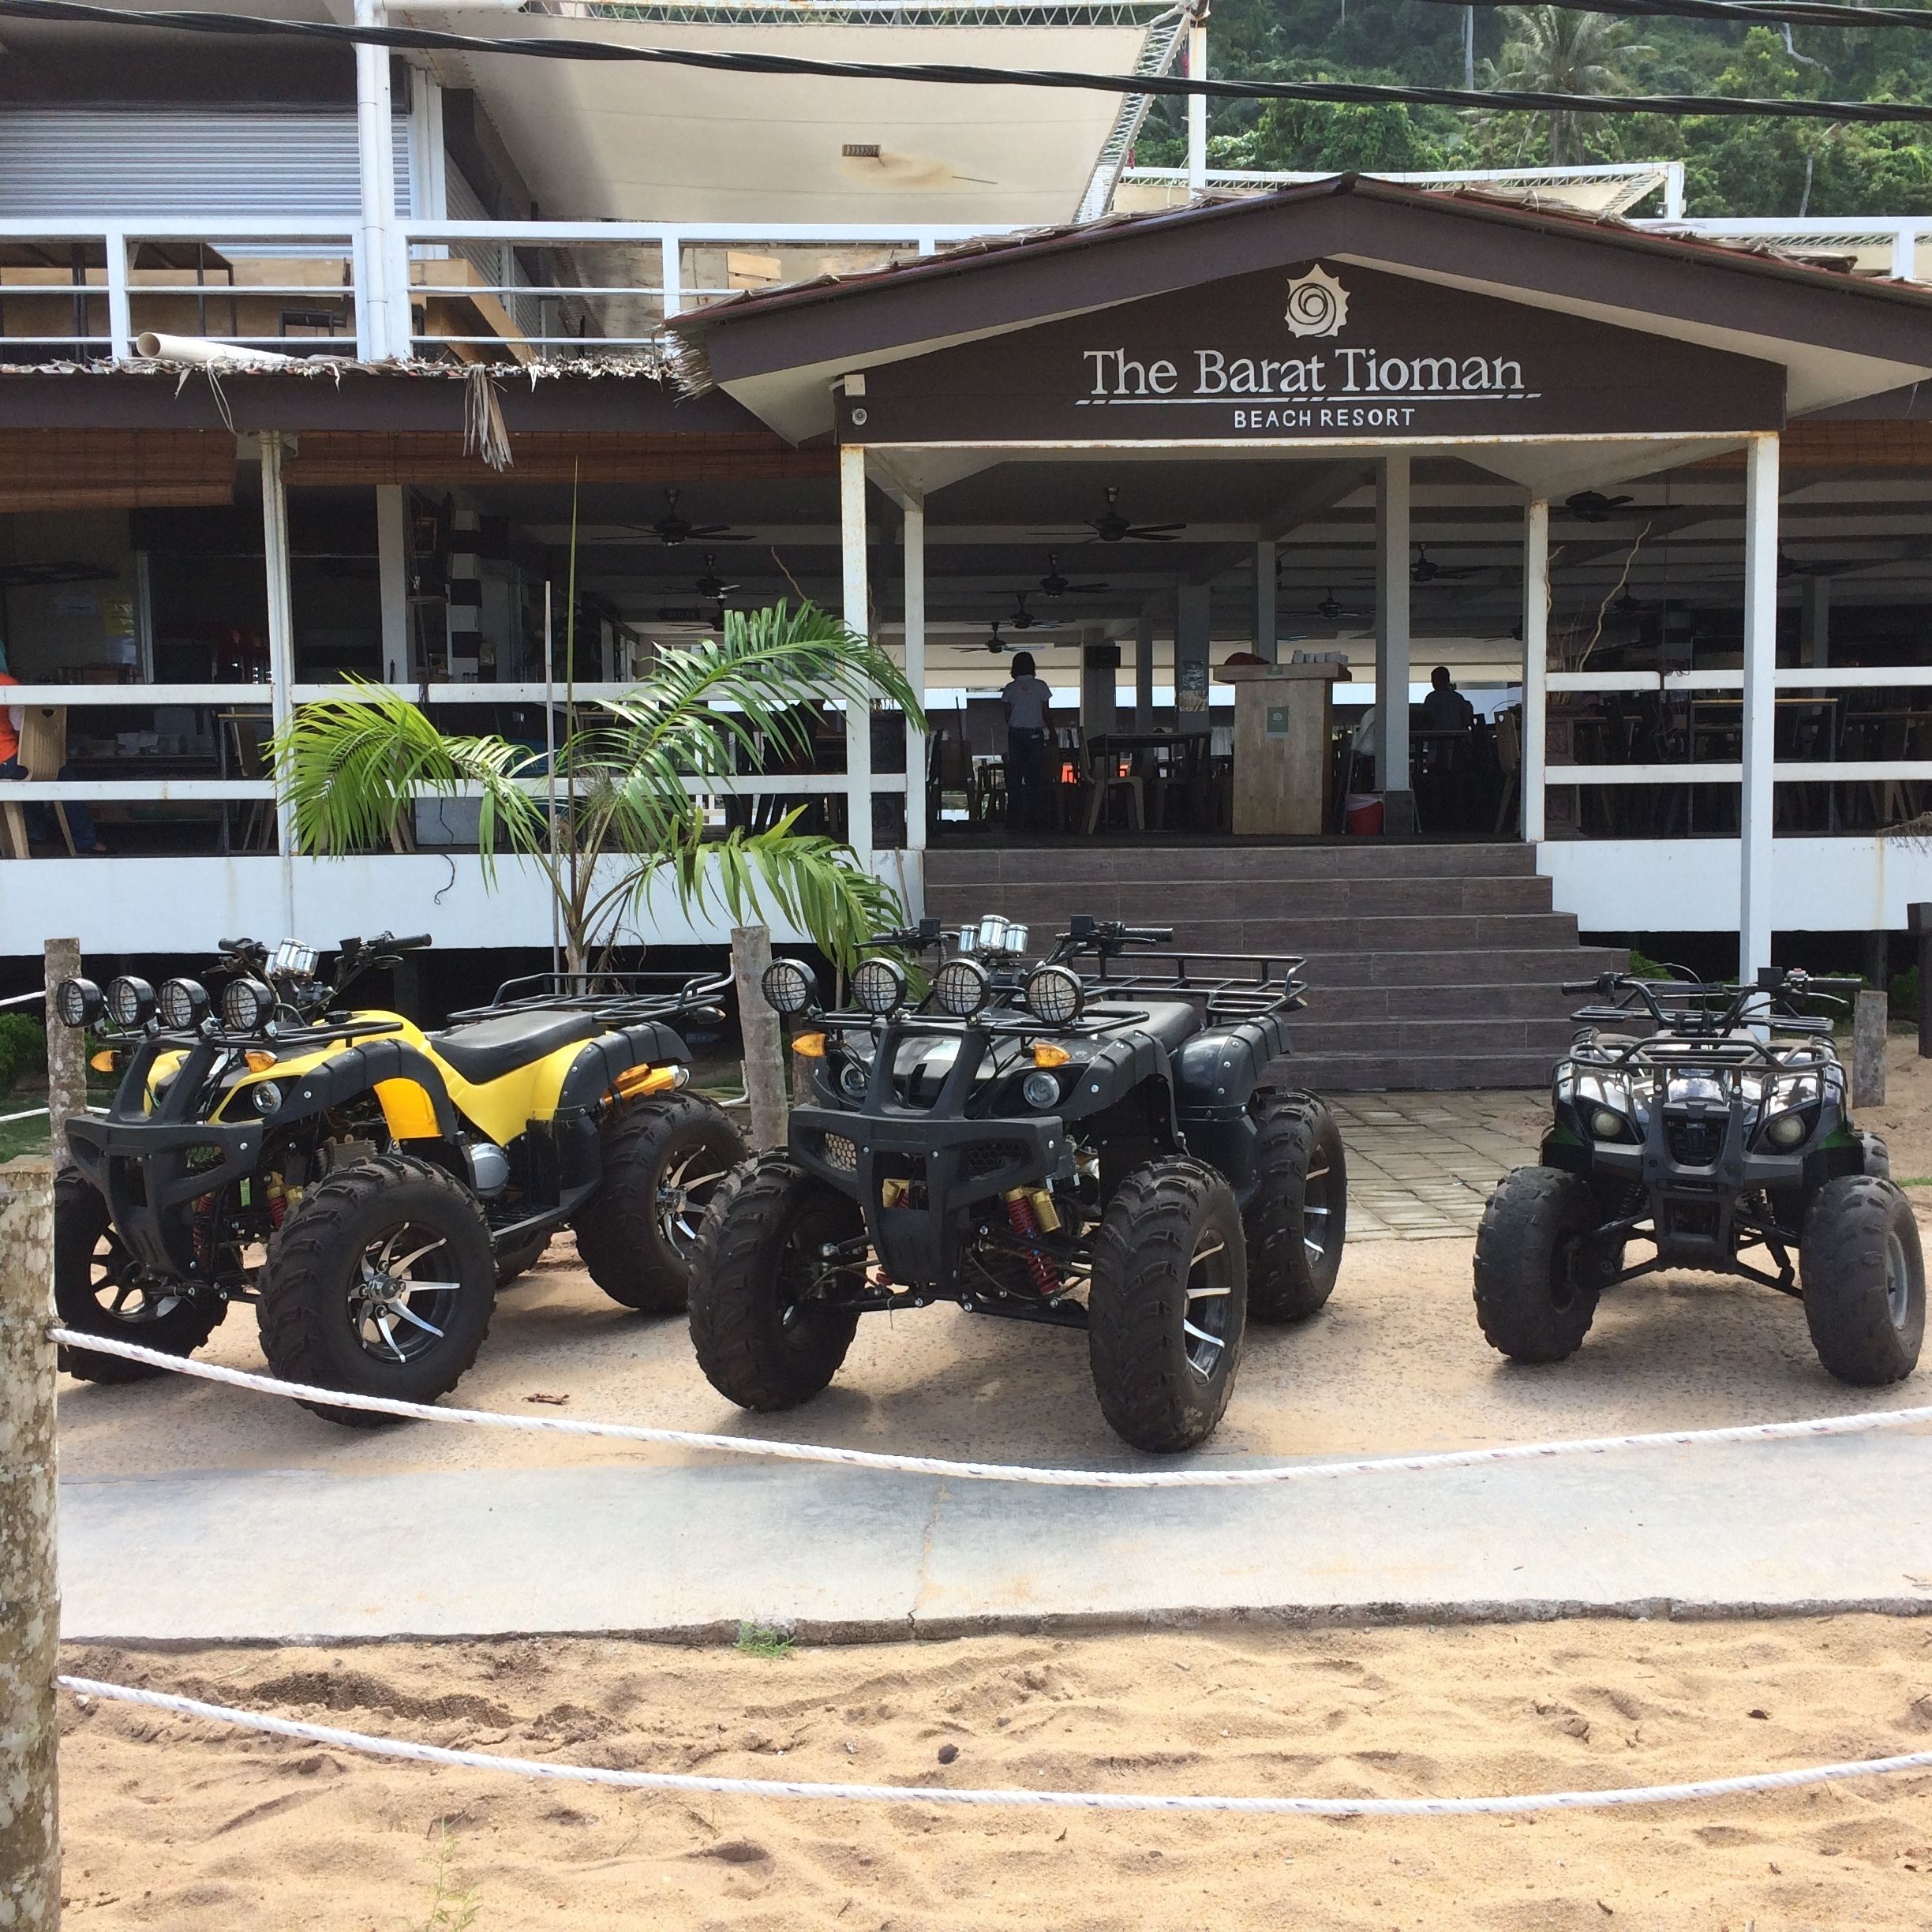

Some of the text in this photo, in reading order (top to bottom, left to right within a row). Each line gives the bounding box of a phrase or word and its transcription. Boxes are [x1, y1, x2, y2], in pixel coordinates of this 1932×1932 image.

[1083, 347, 1525, 395] The Barat Tioman
[1234, 408, 1415, 429] BEACH RESORT
